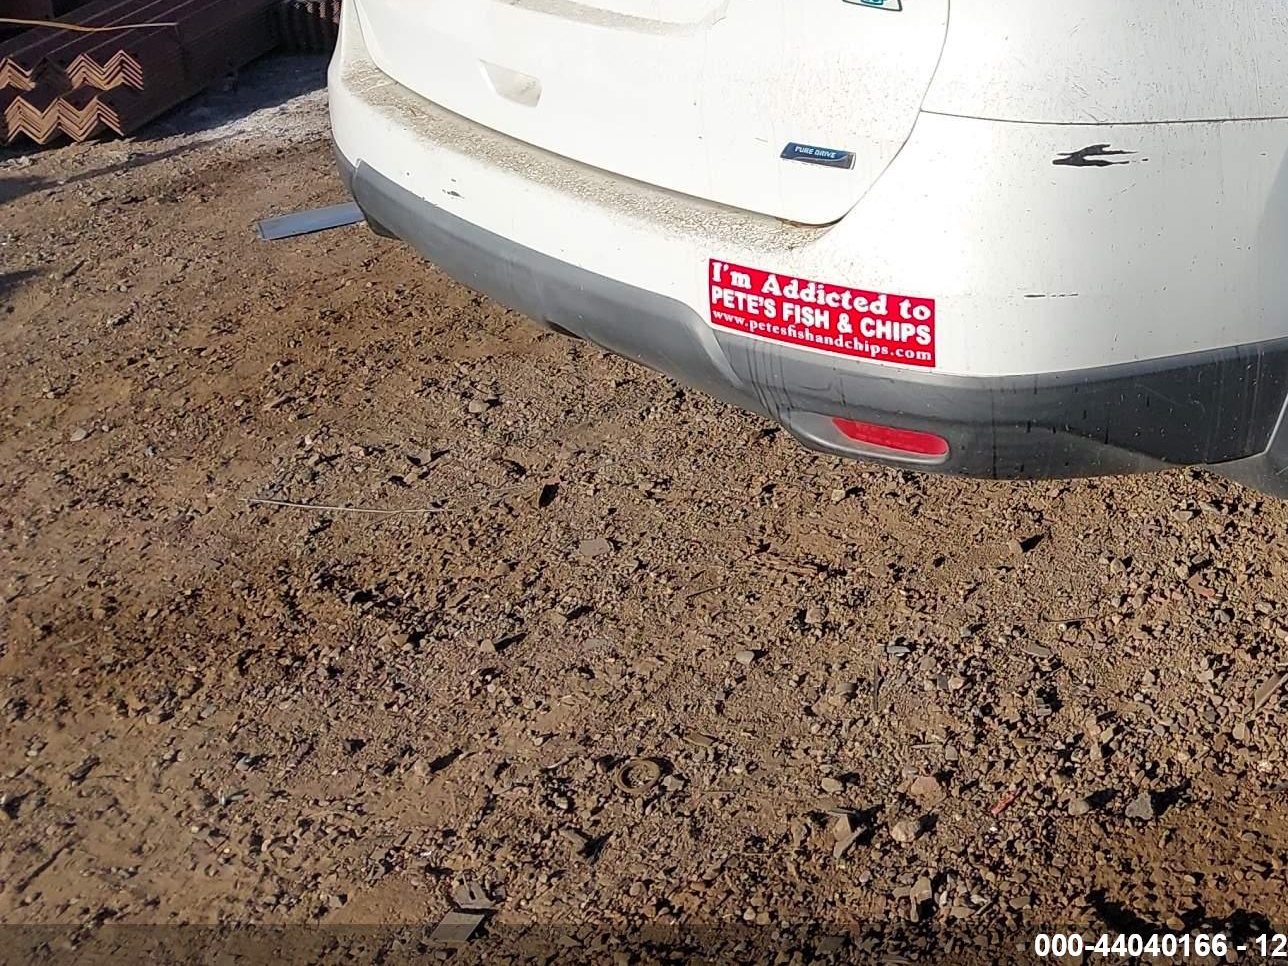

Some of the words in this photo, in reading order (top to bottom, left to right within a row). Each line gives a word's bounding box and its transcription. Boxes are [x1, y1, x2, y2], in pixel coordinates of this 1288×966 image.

[794, 146, 814, 155] PURE
[814, 149, 837, 158] DRIVE
[711, 285, 777, 318] PETE'S
[782, 302, 830, 330] FISH
[836, 313, 853, 334] &
[860, 317, 932, 345] CHIPS
[712, 262, 752, 290] I'm
[761, 274, 889, 316] Addicted
[899, 299, 932, 321] to
[712, 310, 932, 361] www.petesfishandchips.com
